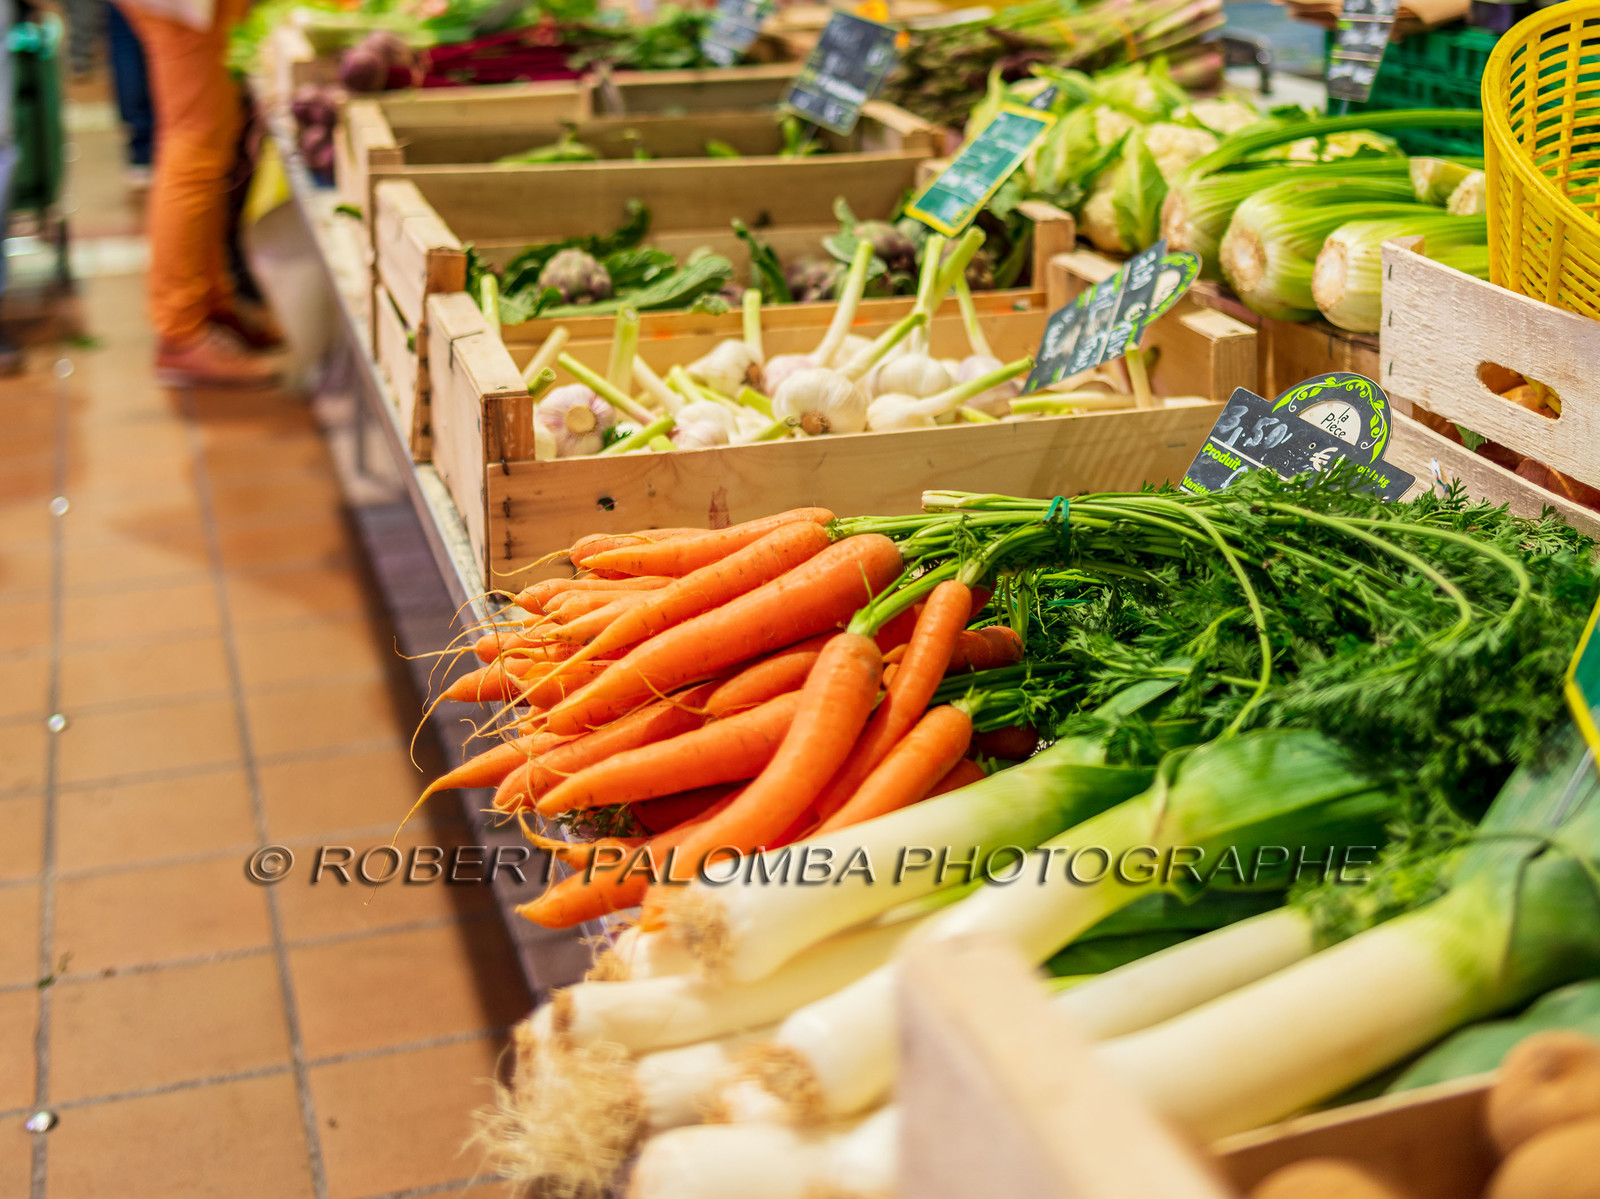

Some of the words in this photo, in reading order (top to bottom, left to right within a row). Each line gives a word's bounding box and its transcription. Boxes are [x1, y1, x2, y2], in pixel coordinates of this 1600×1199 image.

[1202, 442, 1242, 471] Produit
[1309, 446, 1339, 473] €
[1378, 474, 1390, 489] kg
